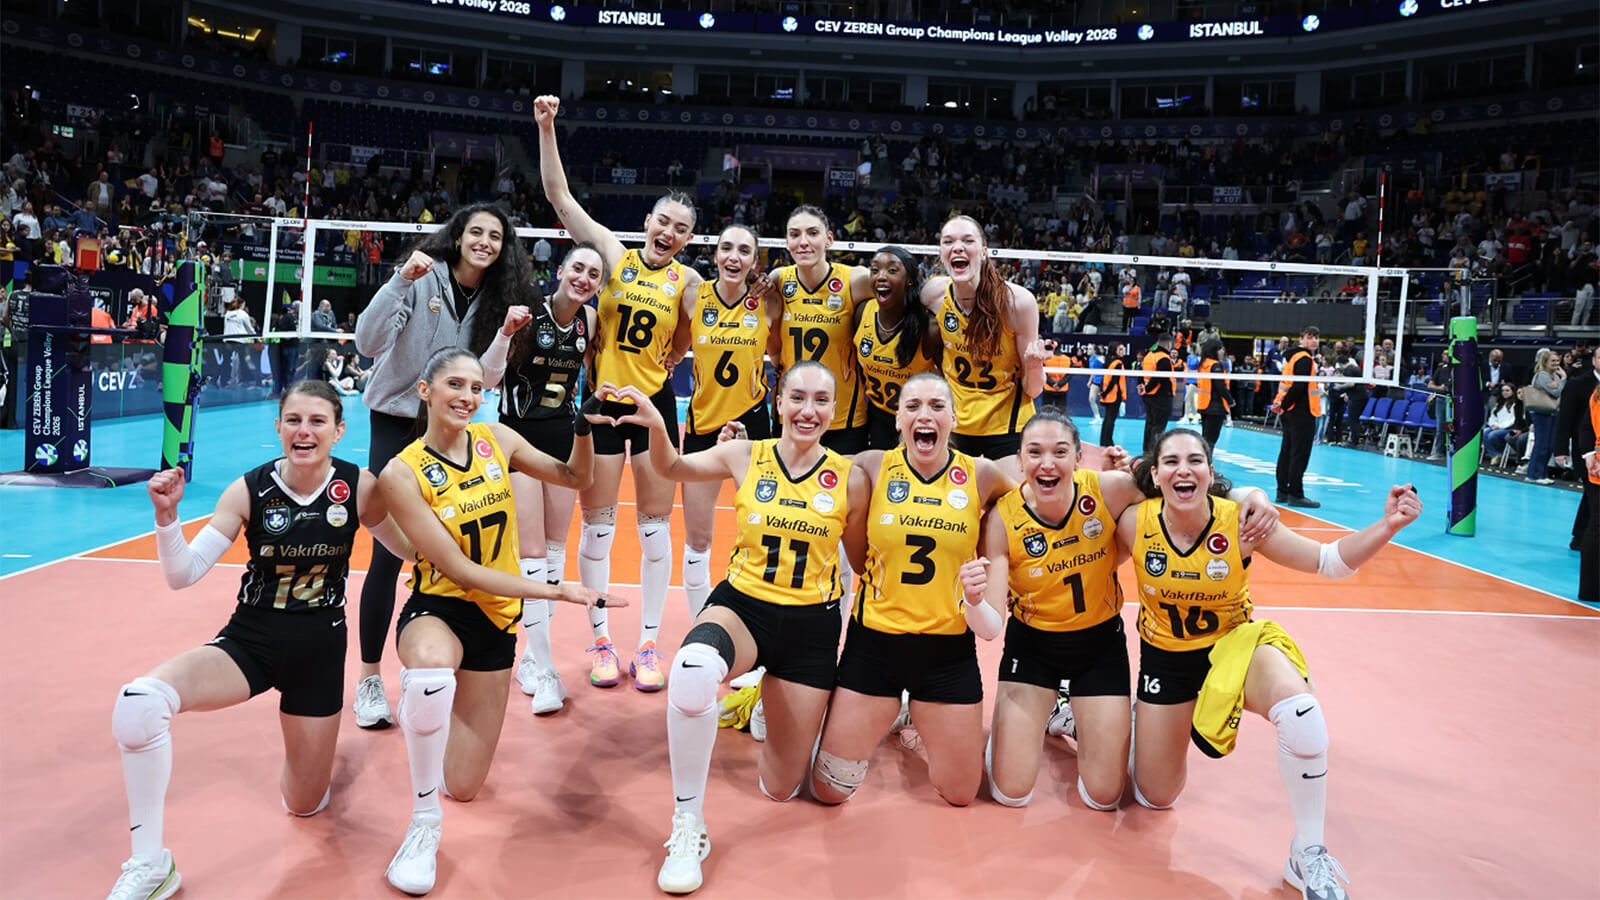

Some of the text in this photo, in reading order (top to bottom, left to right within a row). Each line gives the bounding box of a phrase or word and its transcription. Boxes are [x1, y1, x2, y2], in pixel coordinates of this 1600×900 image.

[499, 1, 531, 15] 2026
[598, 10, 665, 26] ISTANBUL
[814, 19, 1118, 46] CEV ZEREN Group Champions League Volley 2026
[1189, 20, 1264, 38] ISTANBUL
[616, 303, 657, 348] 18
[789, 327, 829, 362] 19
[1060, 343, 1074, 353] ur
[42, 331, 54, 435] Champions League Volley
[98, 371, 127, 392] CEV
[714, 350, 739, 387] 6
[954, 356, 997, 390] 23
[33, 365, 43, 435] CEV ZEREN Group
[77, 383, 86, 431] ISTANBUL
[539, 373, 568, 408] 5
[867, 374, 901, 411] 32
[52, 415, 61, 436] 2026
[459, 510, 508, 566] 17
[761, 534, 810, 589] 11
[900, 534, 937, 585] 3
[273, 564, 329, 609] 14
[1063, 572, 1086, 614] 1
[1158, 601, 1219, 639] 16
[1011, 657, 1019, 673] 1
[1143, 674, 1161, 694] 16
